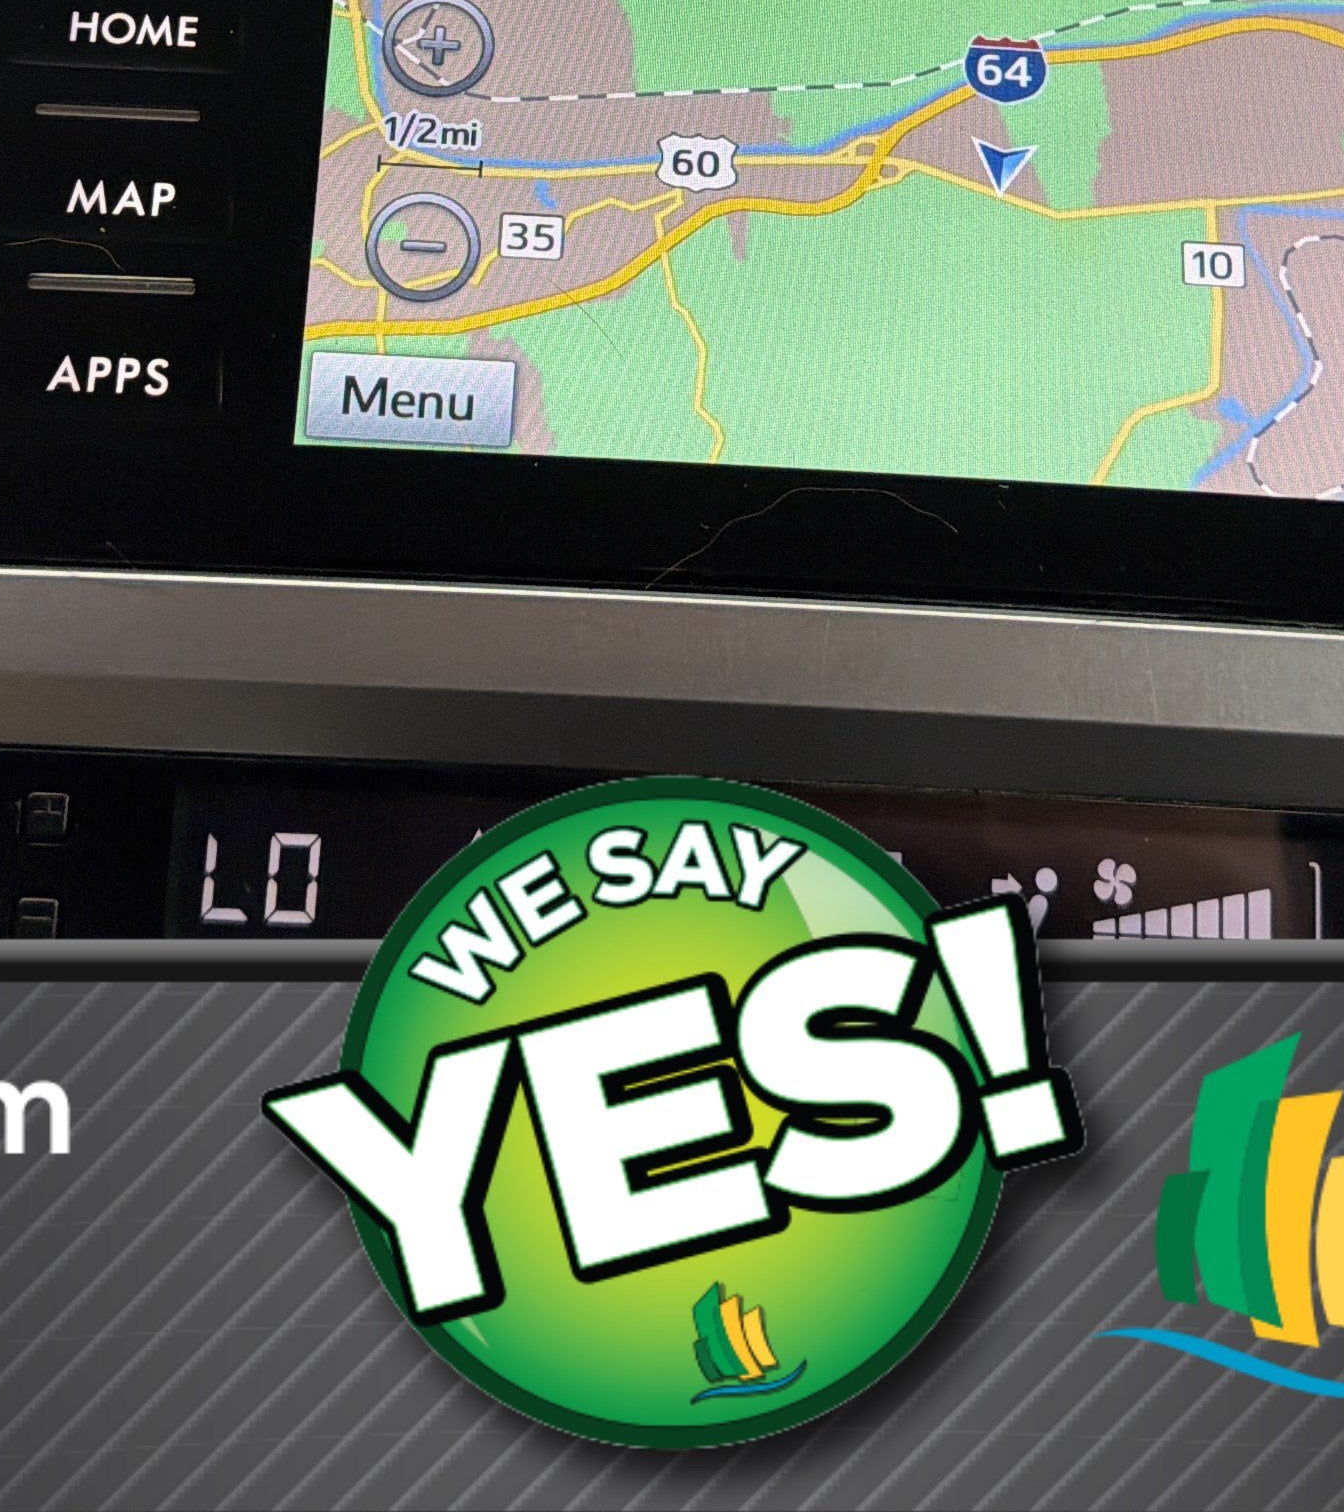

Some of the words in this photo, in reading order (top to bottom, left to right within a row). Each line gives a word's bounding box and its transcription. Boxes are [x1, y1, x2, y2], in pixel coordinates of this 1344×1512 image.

[69, 10, 200, 49] HOME
[975, 54, 1033, 88] 64
[671, 148, 720, 179] 60
[66, 179, 177, 218] MAP
[505, 221, 557, 253] 35
[1192, 250, 1234, 280] 10
[46, 356, 170, 397] APPS
[342, 375, 476, 423] Menu
[200, 832, 323, 925] LO
